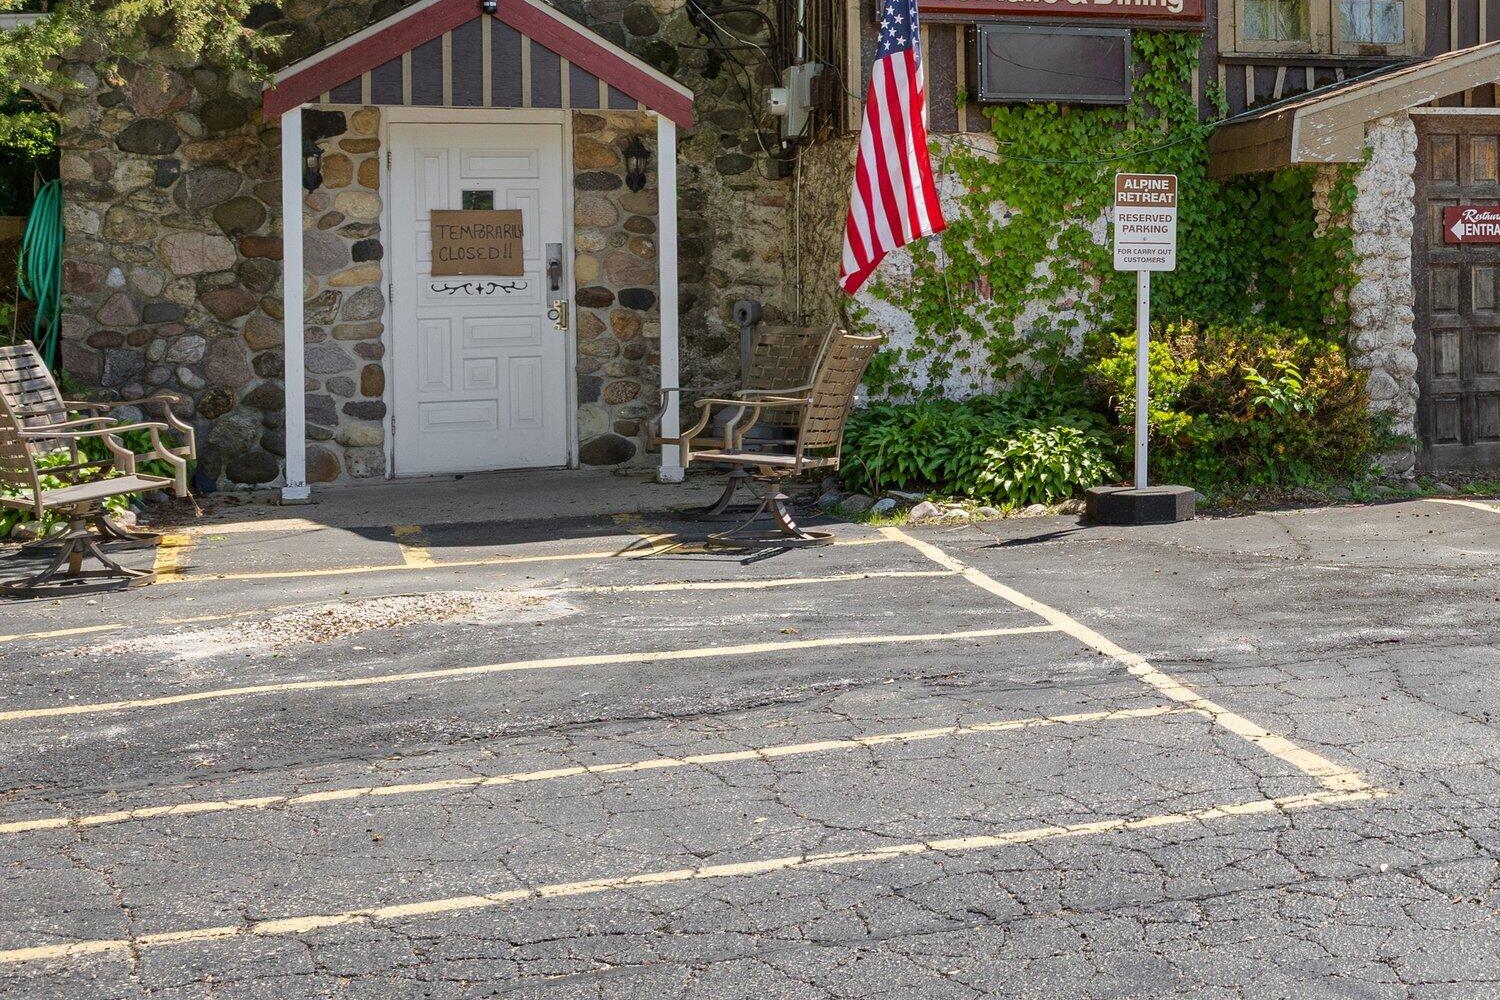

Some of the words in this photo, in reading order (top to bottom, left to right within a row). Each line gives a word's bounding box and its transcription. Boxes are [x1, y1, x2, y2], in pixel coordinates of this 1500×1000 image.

[1124, 179, 1169, 190] ALPINE
[1117, 192, 1174, 203] RETREAT
[1119, 213, 1172, 223] RESERVED
[1122, 224, 1169, 234] PARKING
[439, 242, 512, 262] CLOSED!!
